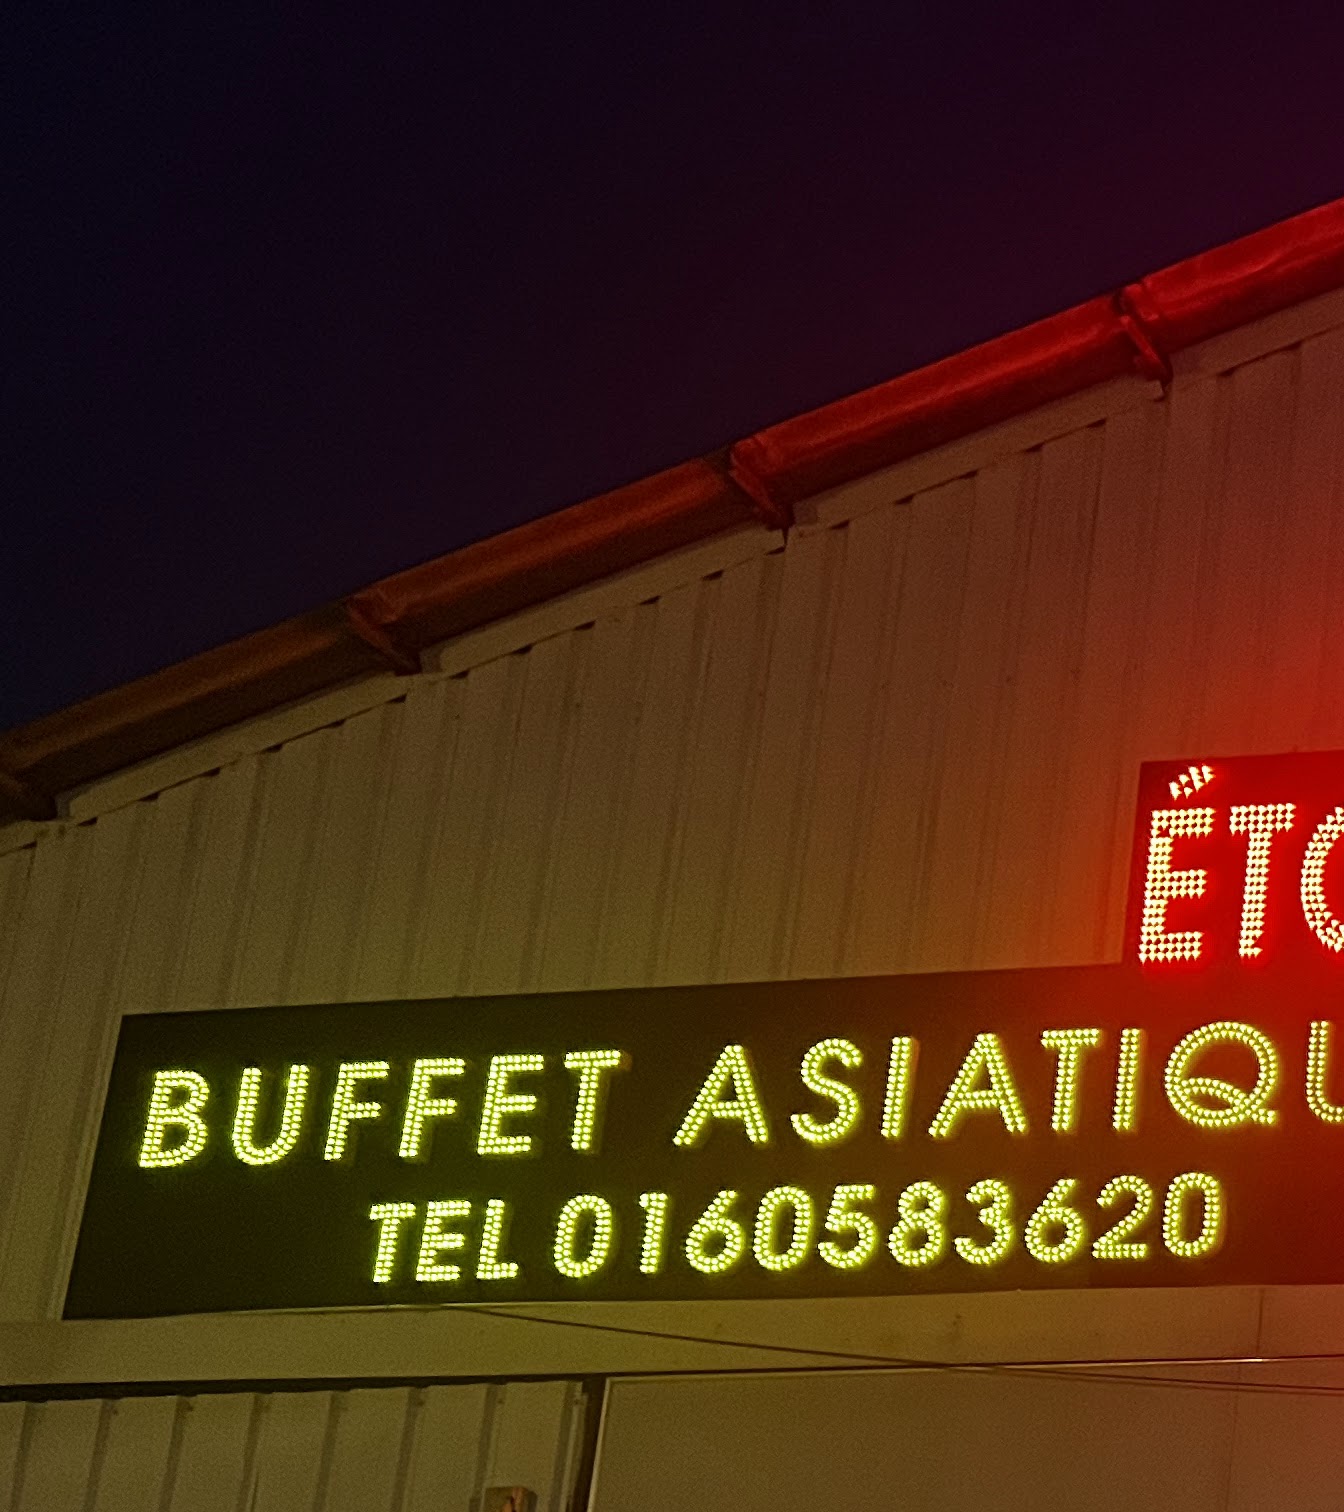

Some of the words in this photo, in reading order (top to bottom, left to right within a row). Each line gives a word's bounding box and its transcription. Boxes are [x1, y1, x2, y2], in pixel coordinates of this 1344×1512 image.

[138, 1049, 624, 1169] BUFFET
[369, 1198, 520, 1284] TEL
[553, 1172, 1223, 1278] 0160583620
